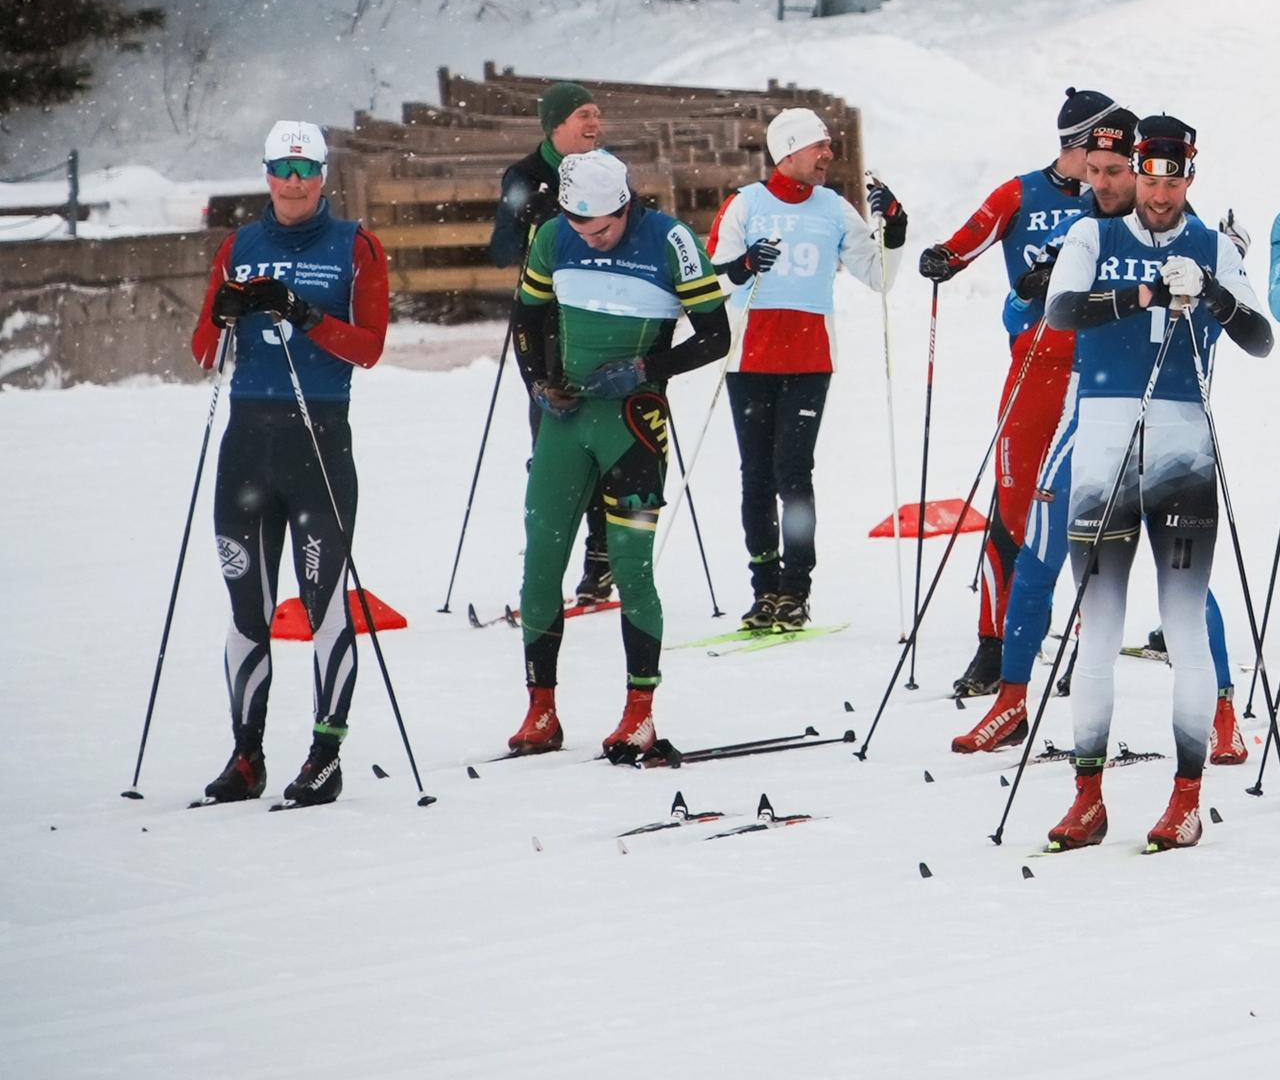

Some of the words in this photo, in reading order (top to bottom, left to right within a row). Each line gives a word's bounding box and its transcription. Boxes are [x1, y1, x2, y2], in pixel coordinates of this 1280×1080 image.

[670, 231, 688, 263] SWECO
[235, 262, 292, 283] RIF
[295, 270, 339, 280] Ingeniørers
[296, 262, 342, 272] Rådgivende
[1097, 256, 1162, 281] RIF
[294, 278, 329, 288] Forening
[974, 699, 1026, 747] alpina
